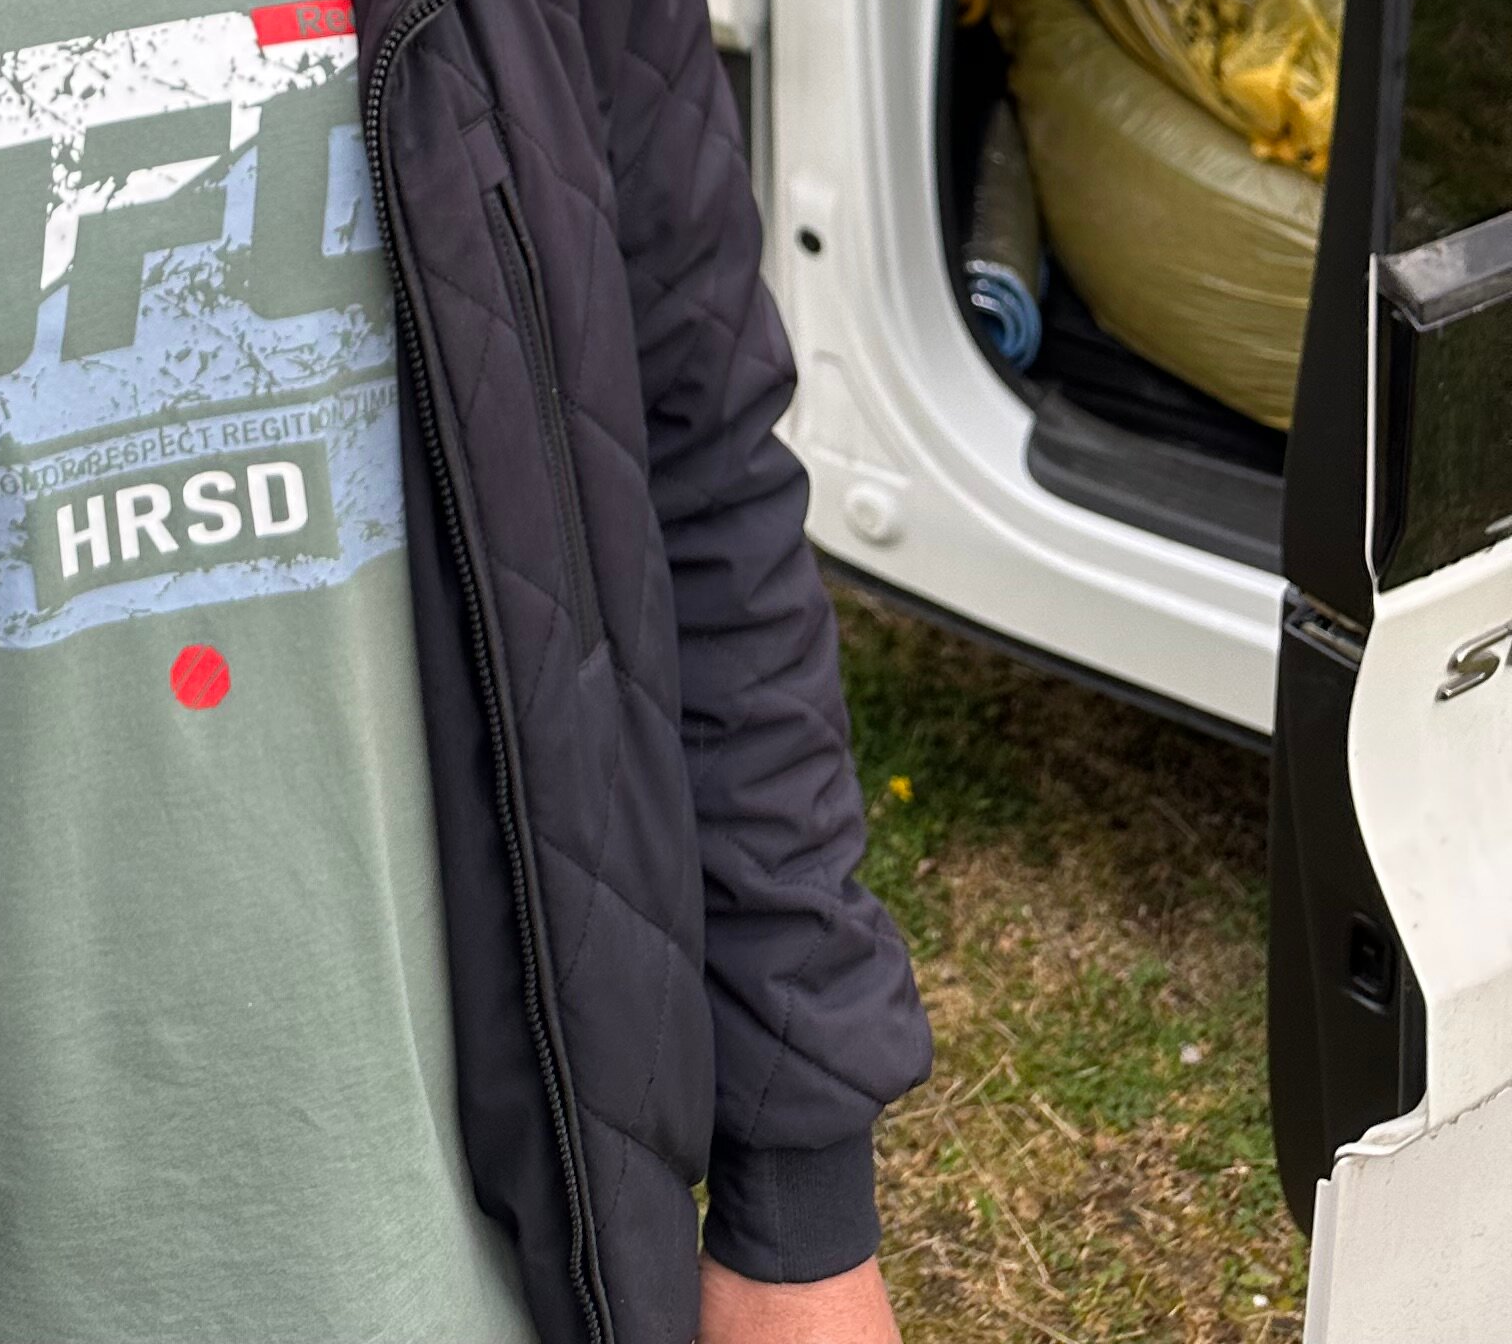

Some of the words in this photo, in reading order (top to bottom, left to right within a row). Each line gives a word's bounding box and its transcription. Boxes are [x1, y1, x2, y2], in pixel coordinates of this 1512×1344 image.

[295, 5, 356, 35] Re
[88, 425, 211, 476] RESPECT
[56, 461, 309, 579] HRSD
[1433, 617, 1512, 704] S
